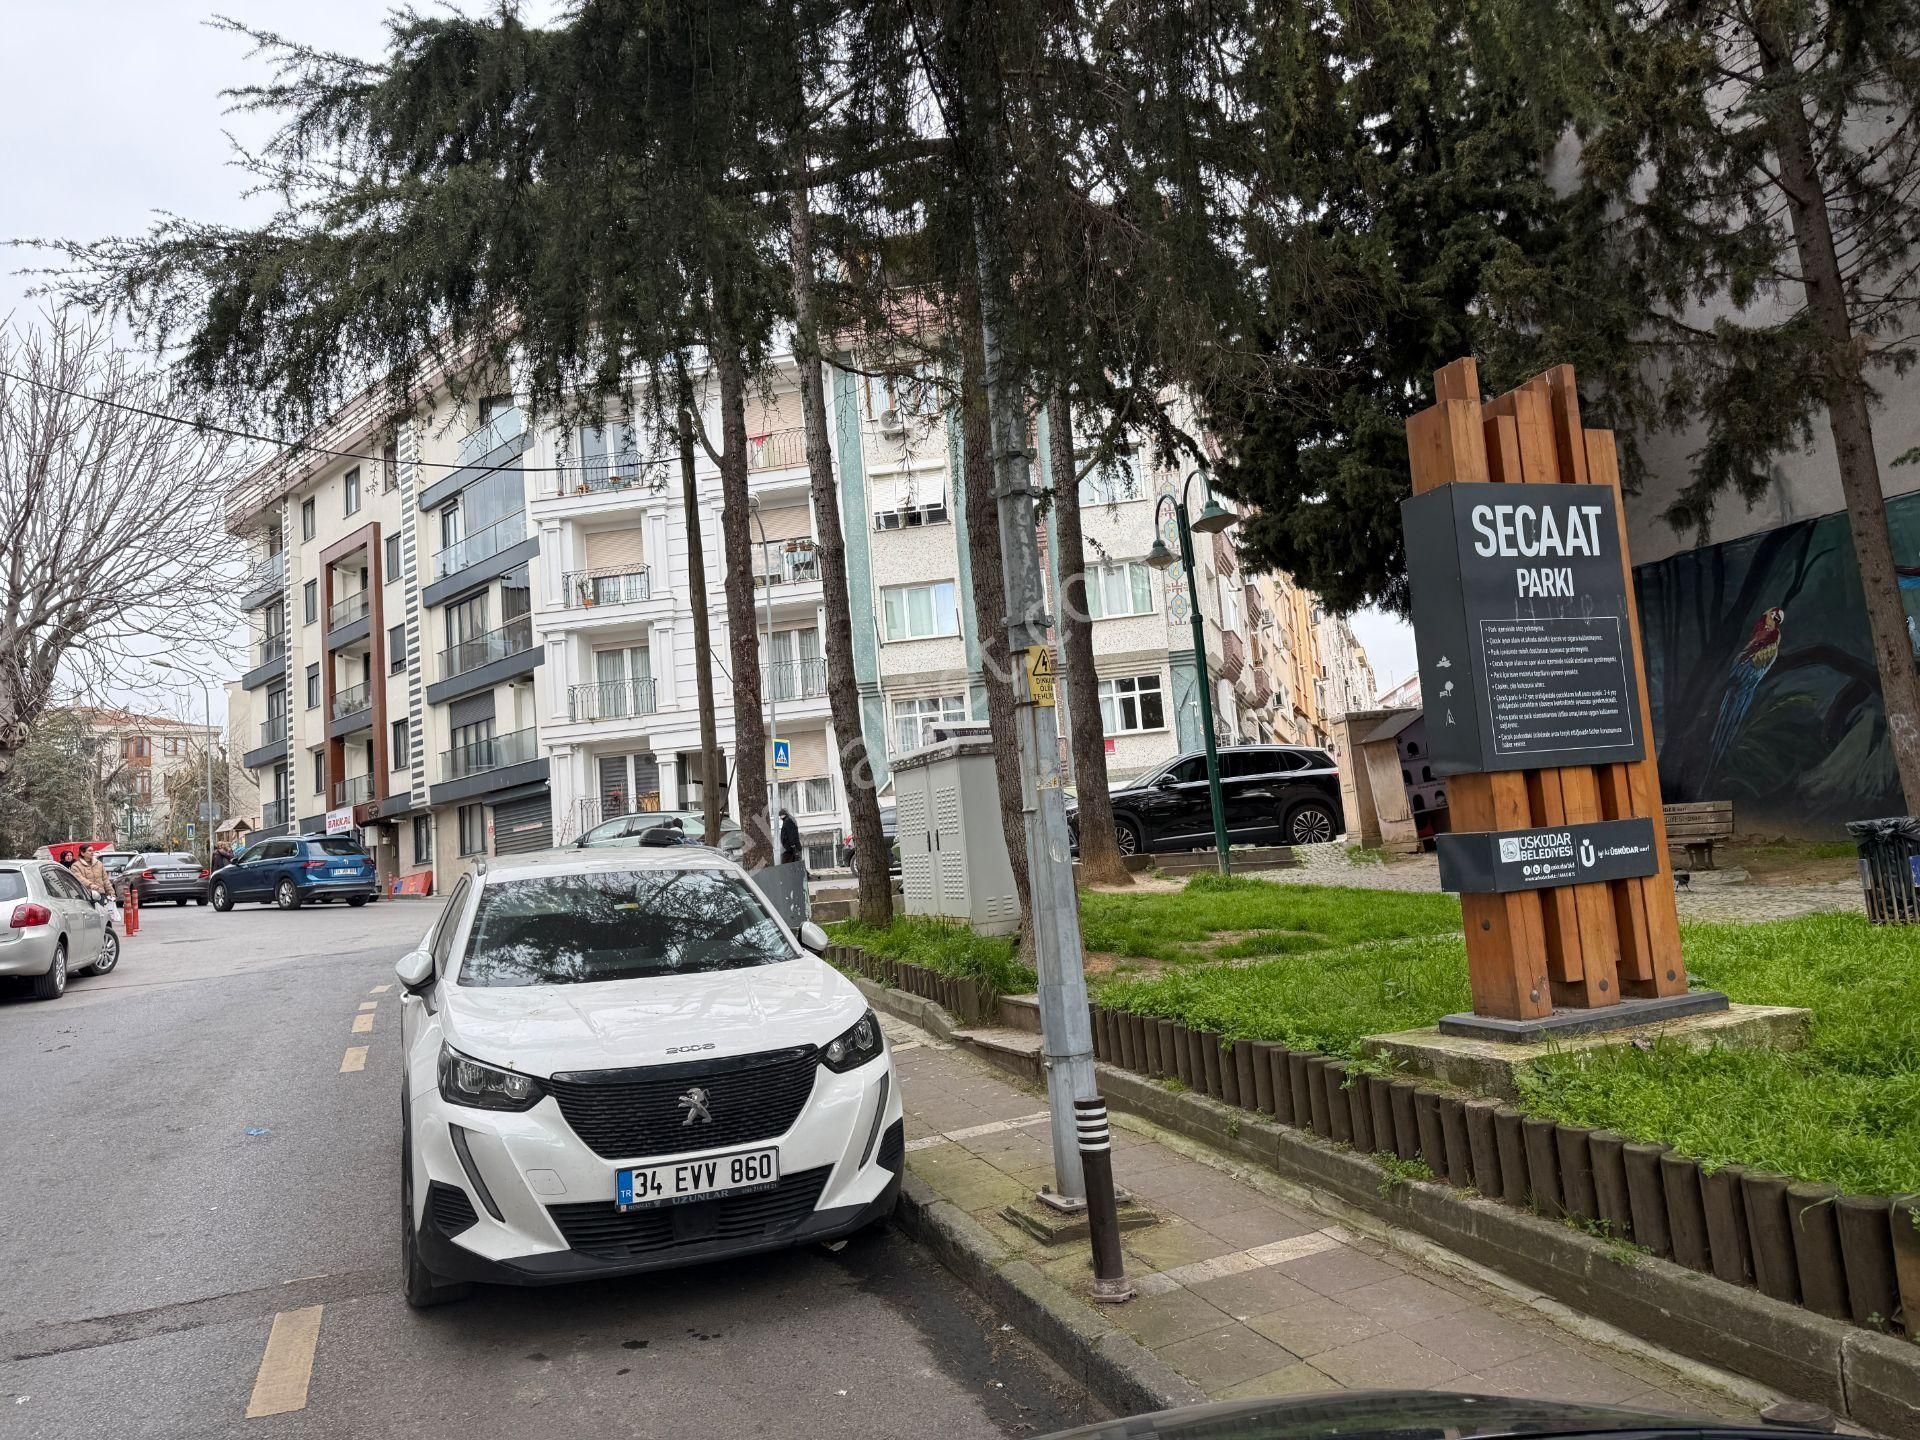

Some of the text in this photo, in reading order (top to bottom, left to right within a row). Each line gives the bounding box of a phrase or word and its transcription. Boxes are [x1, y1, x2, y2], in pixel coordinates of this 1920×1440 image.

[1472, 504, 1602, 558] SECAAT
[1516, 567, 1574, 598] PARKI
[1520, 832, 1571, 849] ÜSKÜDAR
[635, 1154, 771, 1198] 34 EVV 860
[621, 1190, 632, 1198] TR
[672, 1190, 729, 1204] UZUNLAR
